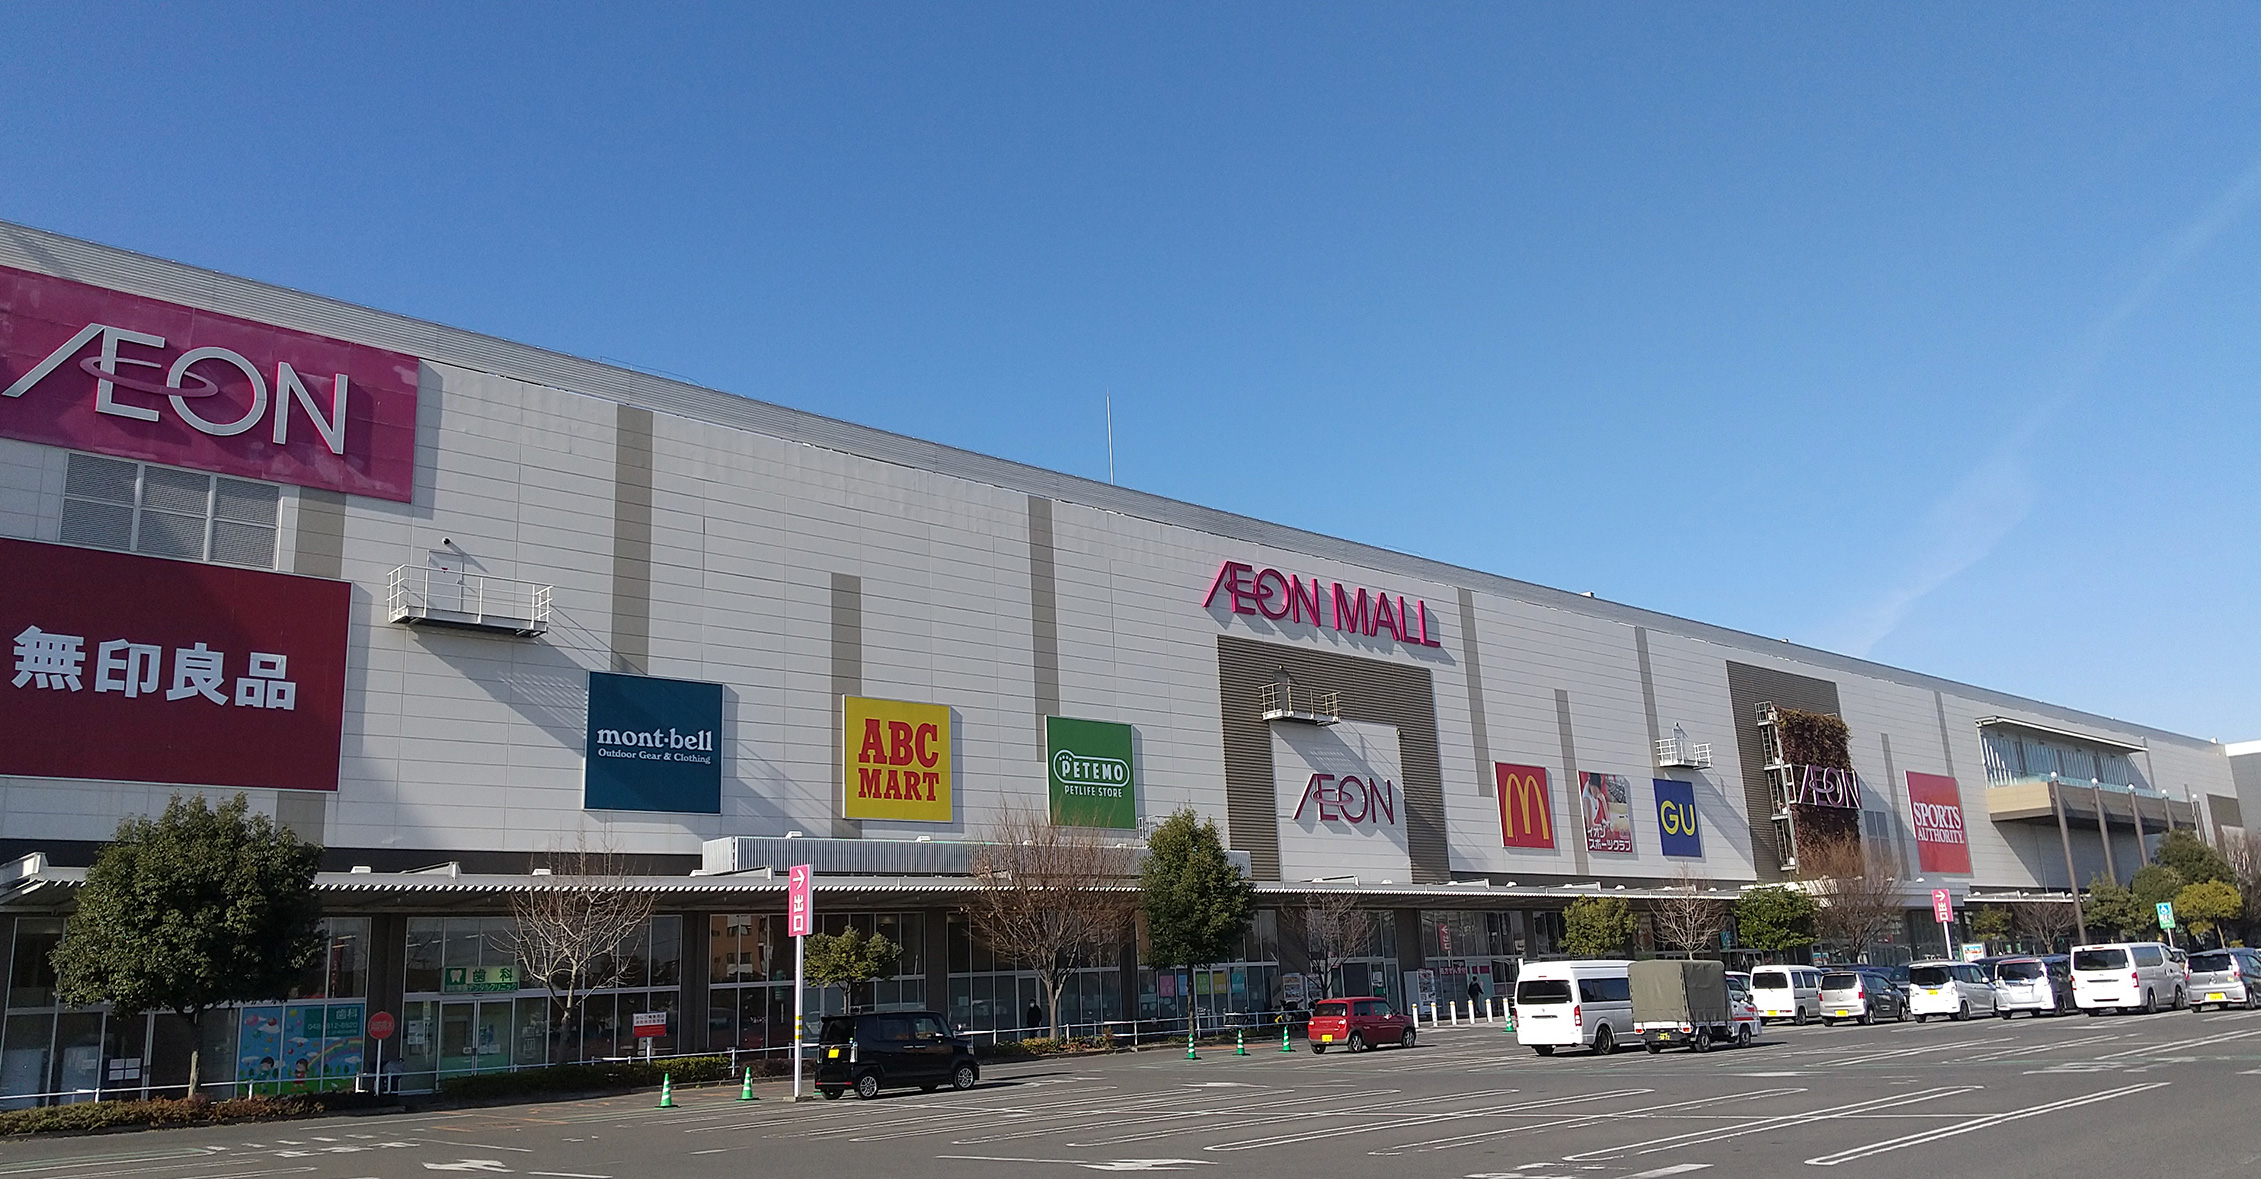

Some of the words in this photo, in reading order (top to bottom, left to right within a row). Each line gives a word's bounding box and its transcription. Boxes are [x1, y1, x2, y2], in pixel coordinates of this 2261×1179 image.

[1332, 582, 1441, 648] MALL
[11, 625, 297, 711] 無印良品
[598, 748, 637, 759] Outdoor
[638, 751, 662, 761] Gear
[663, 752, 672, 761] &
[674, 753, 711, 765] Clothing
[858, 718, 939, 769] ABC
[1061, 758, 1124, 782] PETEMO
[858, 767, 940, 802] MART
[1064, 785, 1096, 797] PETLIFE
[1099, 786, 1123, 798] STORE
[1660, 800, 1696, 836] GU
[1913, 802, 1963, 830] SPORTS
[1917, 826, 1965, 845] AUTHORITY
[793, 894, 804, 932] 出口
[1938, 902, 1949, 921] 出口
[473, 968, 513, 982] 歯科
